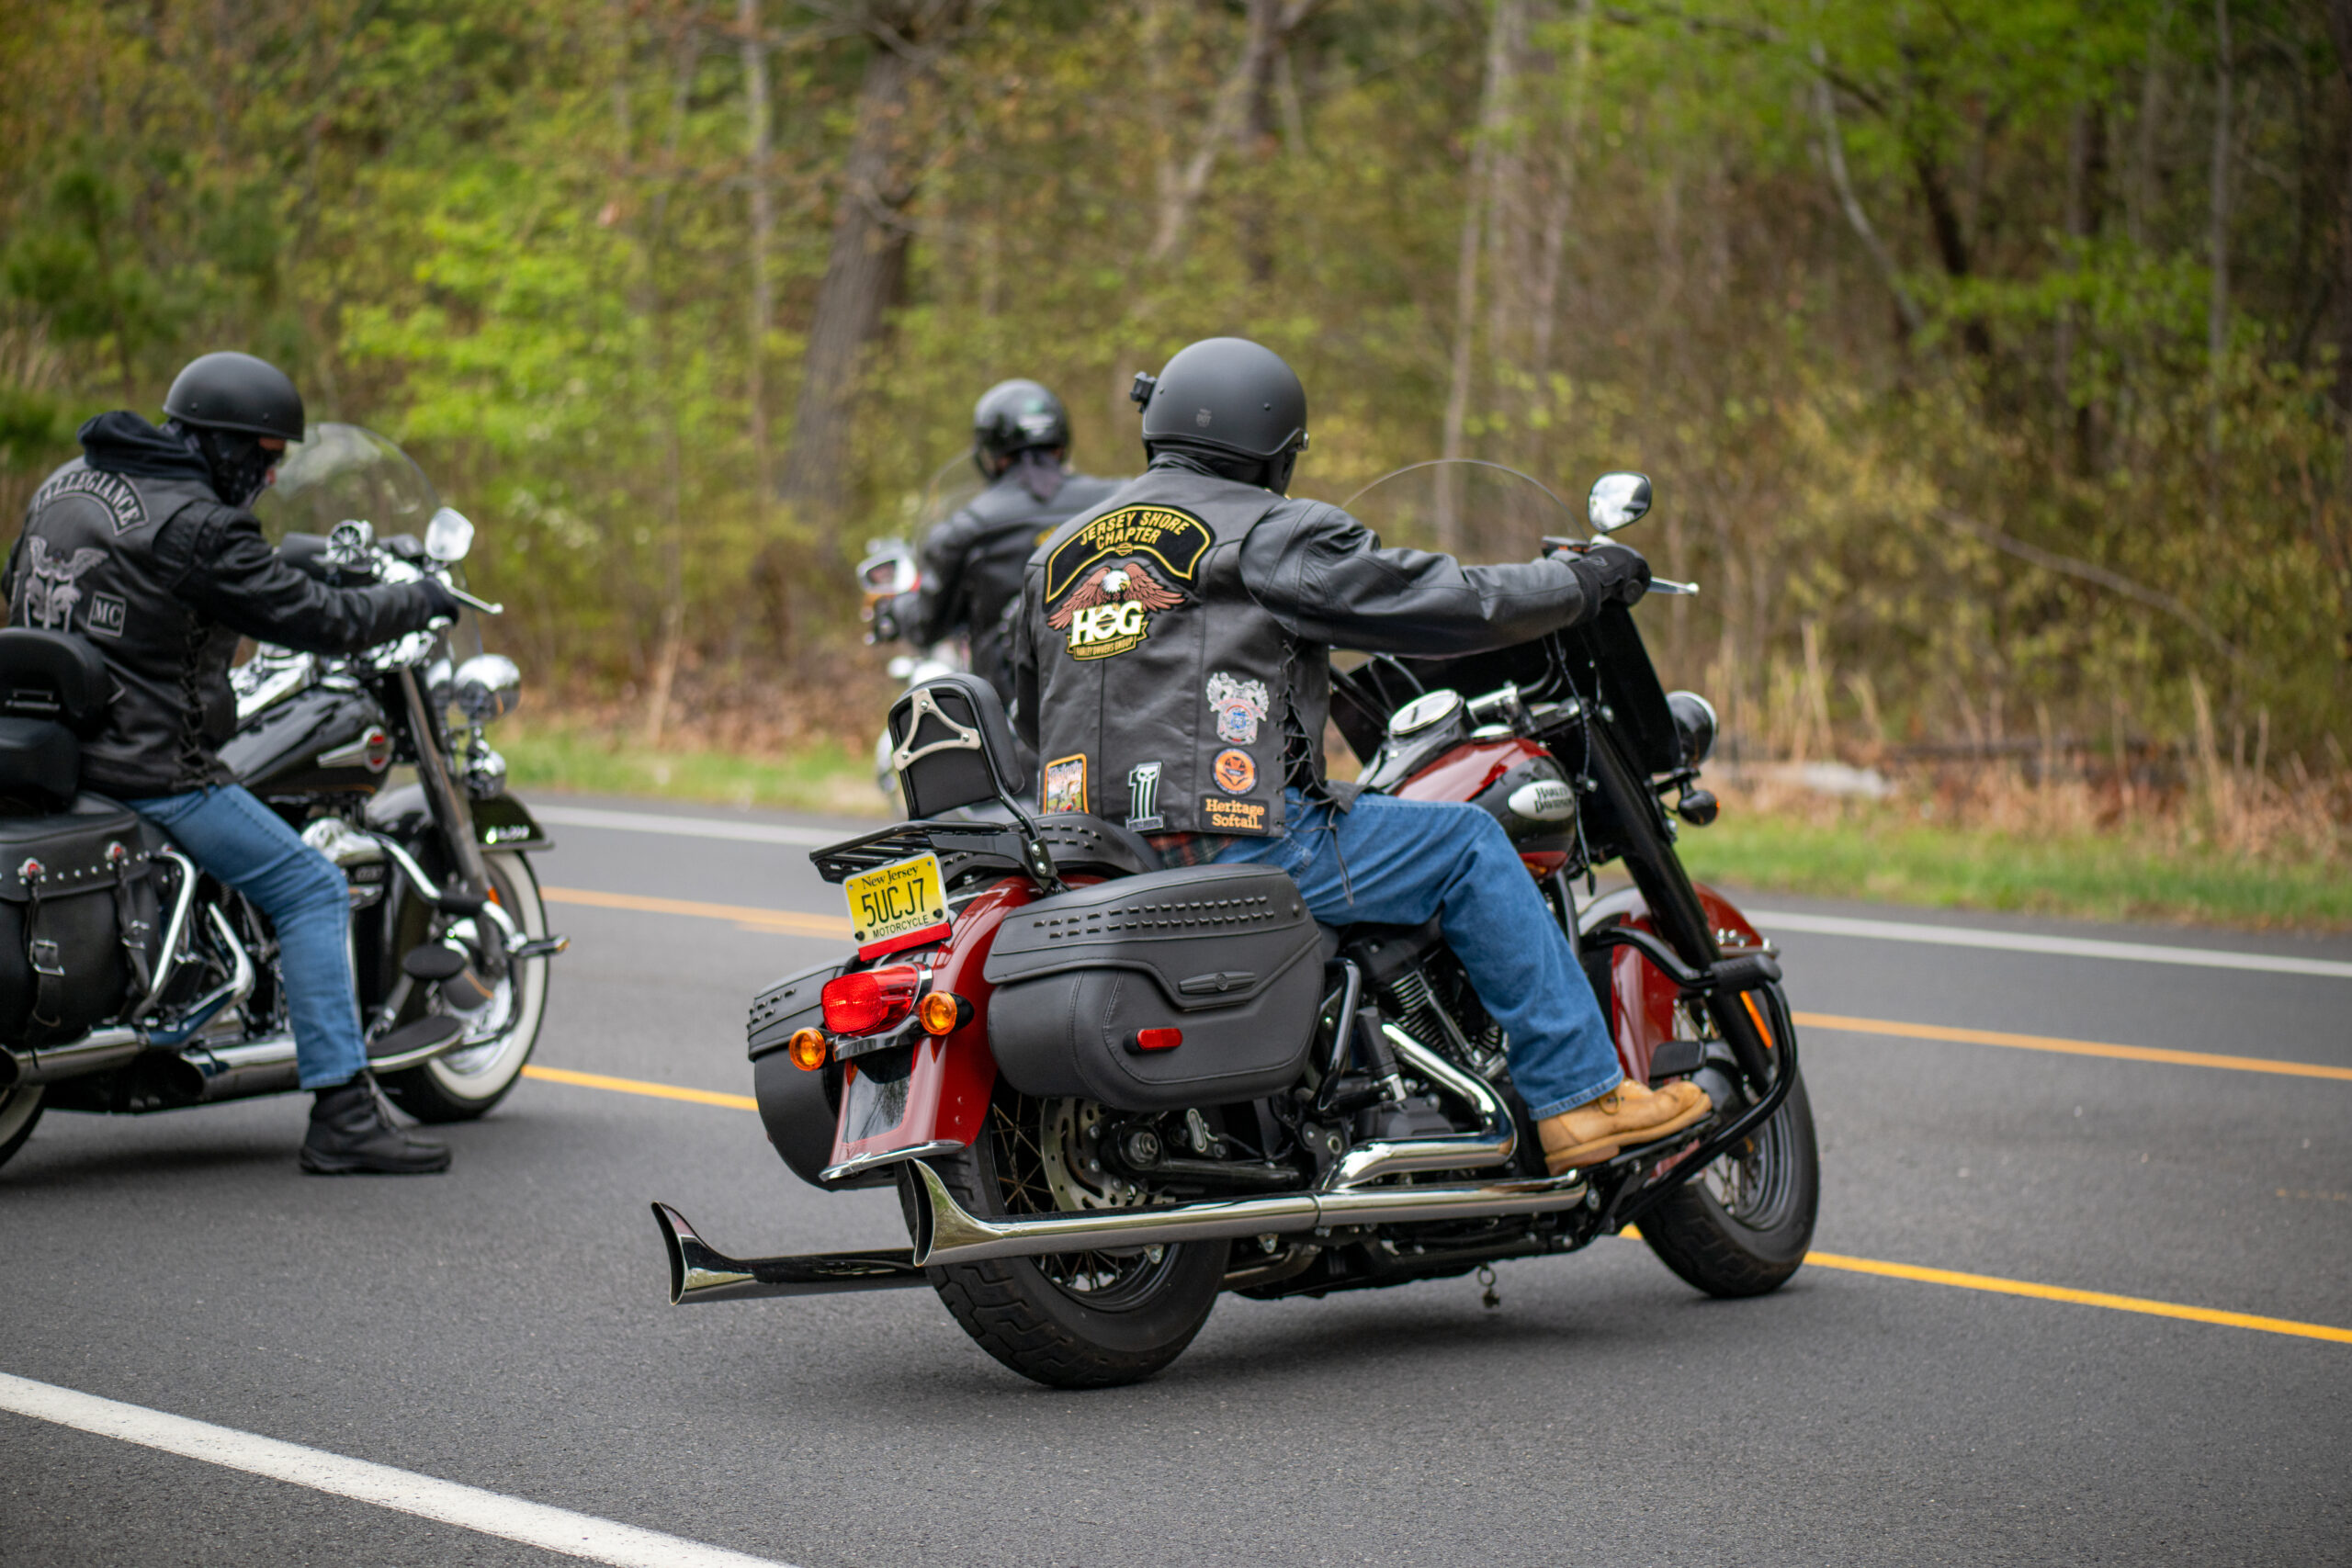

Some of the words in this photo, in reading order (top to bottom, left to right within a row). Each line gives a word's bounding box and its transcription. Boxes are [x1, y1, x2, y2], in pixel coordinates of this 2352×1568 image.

[43, 471, 140, 526] ALLEGIANCE
[1080, 512, 1136, 546] JERSEY
[1140, 512, 1190, 536] SHORE
[1096, 526, 1161, 550] CHAPTER
[92, 602, 122, 627] MC
[1070, 600, 1145, 648] HOG
[1205, 798, 1264, 817] Heritage
[862, 876, 885, 889] New
[887, 865, 919, 884] Jersey
[861, 877, 923, 928] 5UCJ7
[873, 914, 929, 938] MOTORCYCLE
